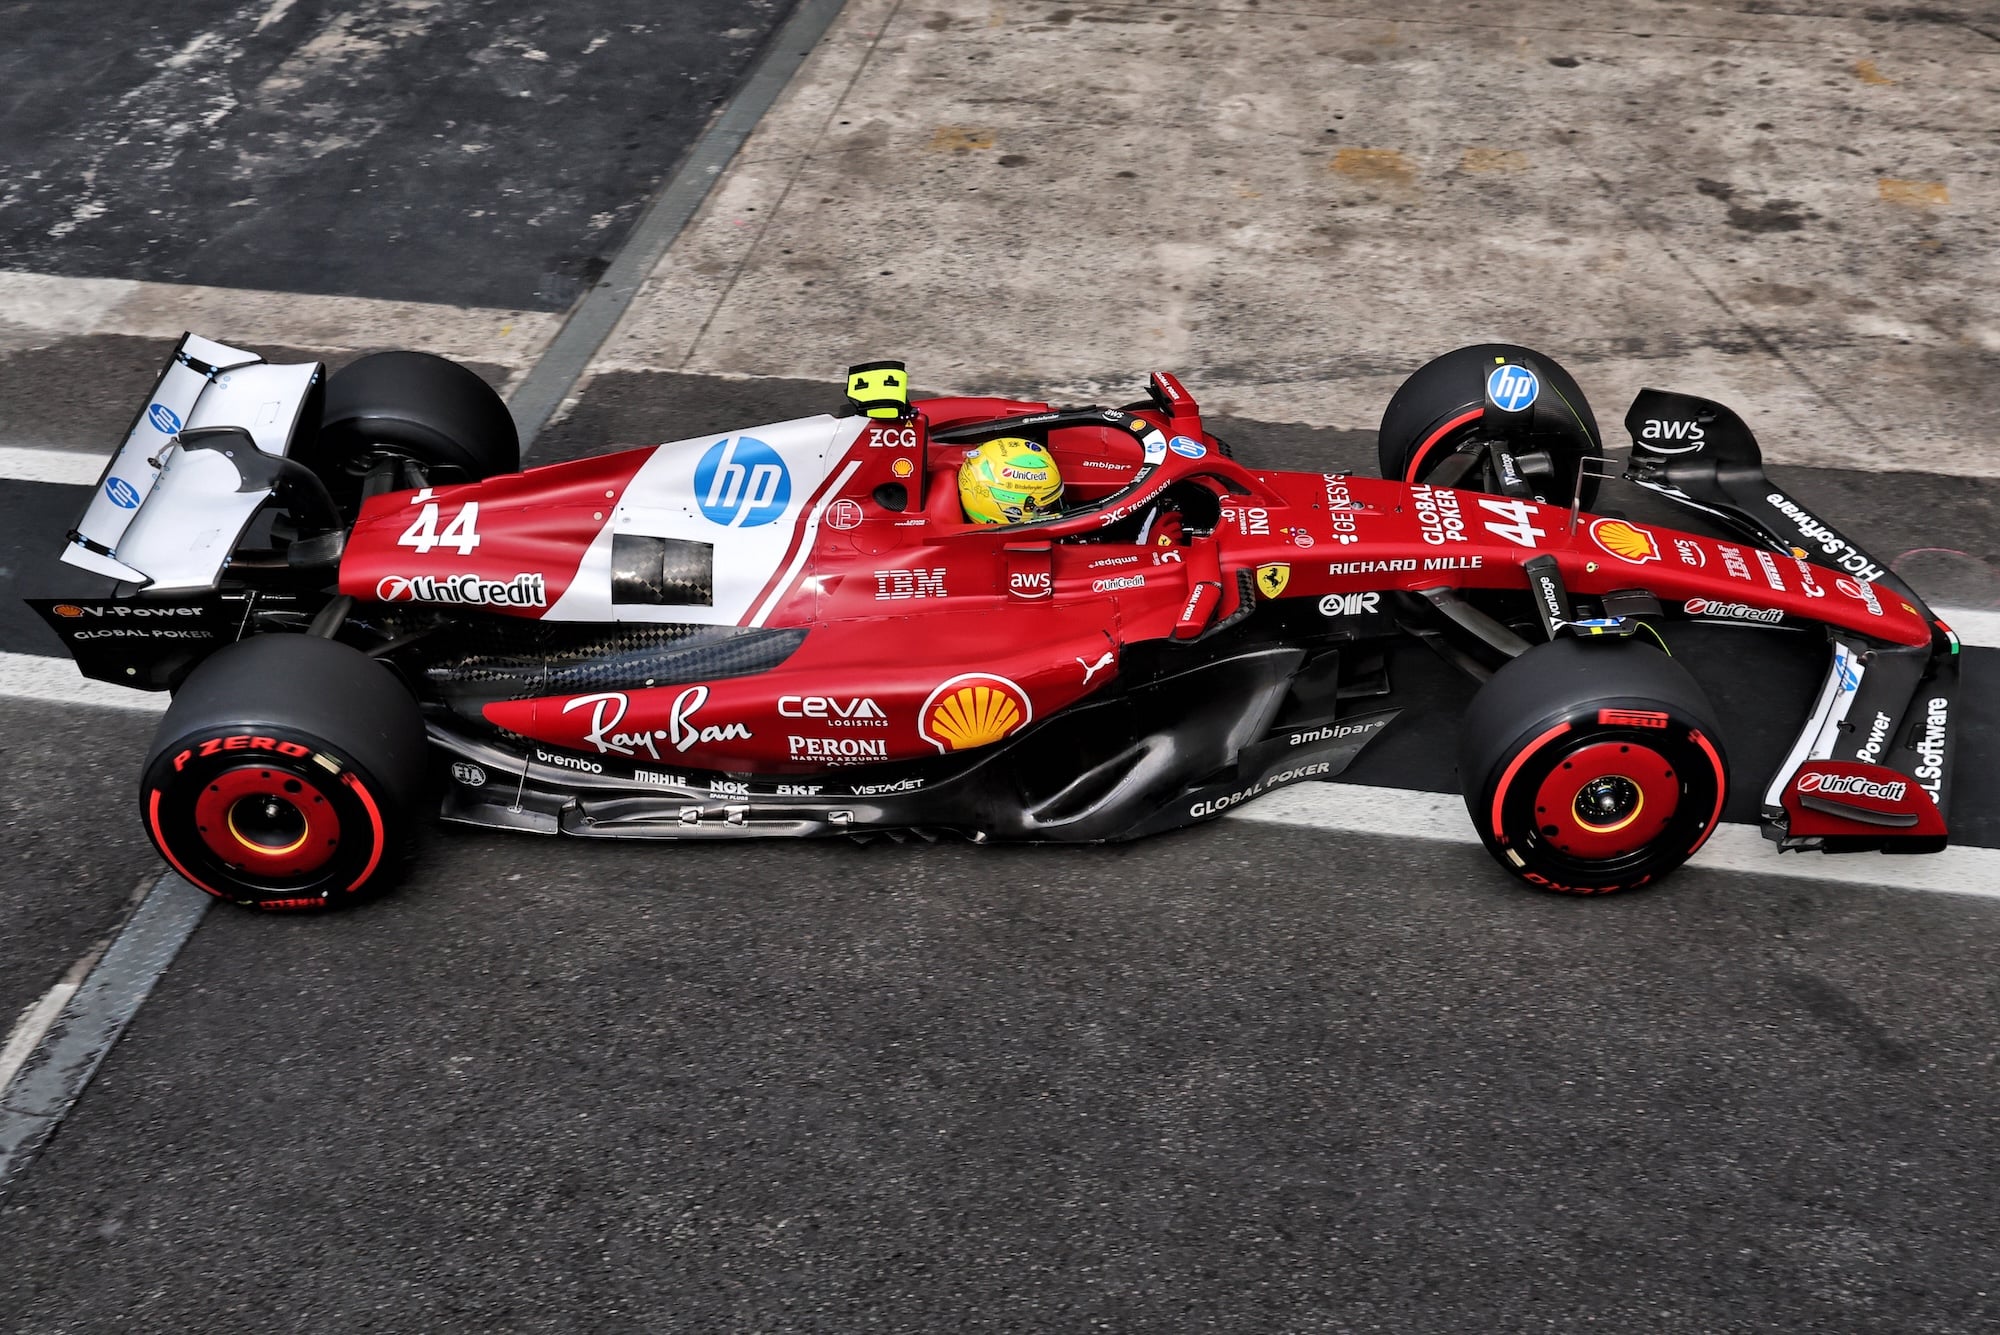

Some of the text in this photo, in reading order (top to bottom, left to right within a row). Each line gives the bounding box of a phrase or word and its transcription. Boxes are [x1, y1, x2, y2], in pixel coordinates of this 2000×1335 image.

[1494, 366, 1532, 411] hp
[149, 404, 181, 434] hp
[1104, 408, 1126, 420] aws
[1641, 418, 1705, 441] aws
[1011, 470, 1047, 481] UniCredit
[1082, 459, 1126, 471] ambipar
[106, 477, 140, 508] hp
[698, 437, 788, 528] hp
[1098, 478, 1171, 527] DXC TECHNOLOGY
[1323, 473, 1356, 532] GENESYS
[1410, 484, 1445, 545] GLOBAL
[1434, 490, 1467, 541] POKER
[397, 501, 481, 555] 44
[1477, 498, 1546, 548] 44
[1673, 538, 1698, 566] aws
[1766, 493, 1885, 583] HCLSoftware
[1093, 555, 1139, 567] ambipar
[1329, 556, 1482, 575] RICHARD MILLE
[1717, 543, 1752, 581] IBM
[1755, 549, 1786, 592] PIRELLI
[413, 574, 545, 606] UniCredit
[873, 567, 948, 600] IBM
[1009, 571, 1051, 589] aws
[1103, 574, 1146, 590] UniCredit
[1540, 576, 1561, 616] vantage
[83, 606, 204, 617] V-Power
[1705, 600, 1785, 624] UniCredit
[74, 629, 214, 640] GLOBAL POKER
[827, 719, 889, 727] LOGISTICS
[1288, 722, 1375, 746] ambipar
[787, 735, 888, 756] PERONI
[1856, 711, 1892, 764] Power
[173, 735, 314, 772] P ZERO
[536, 748, 603, 774] brembo
[634, 769, 687, 787] MAHLE
[710, 780, 750, 795] NGK
[776, 784, 824, 796] SKF
[1189, 762, 1330, 818] GLOBAL POKER
[1819, 775, 1907, 801] UniCredit
